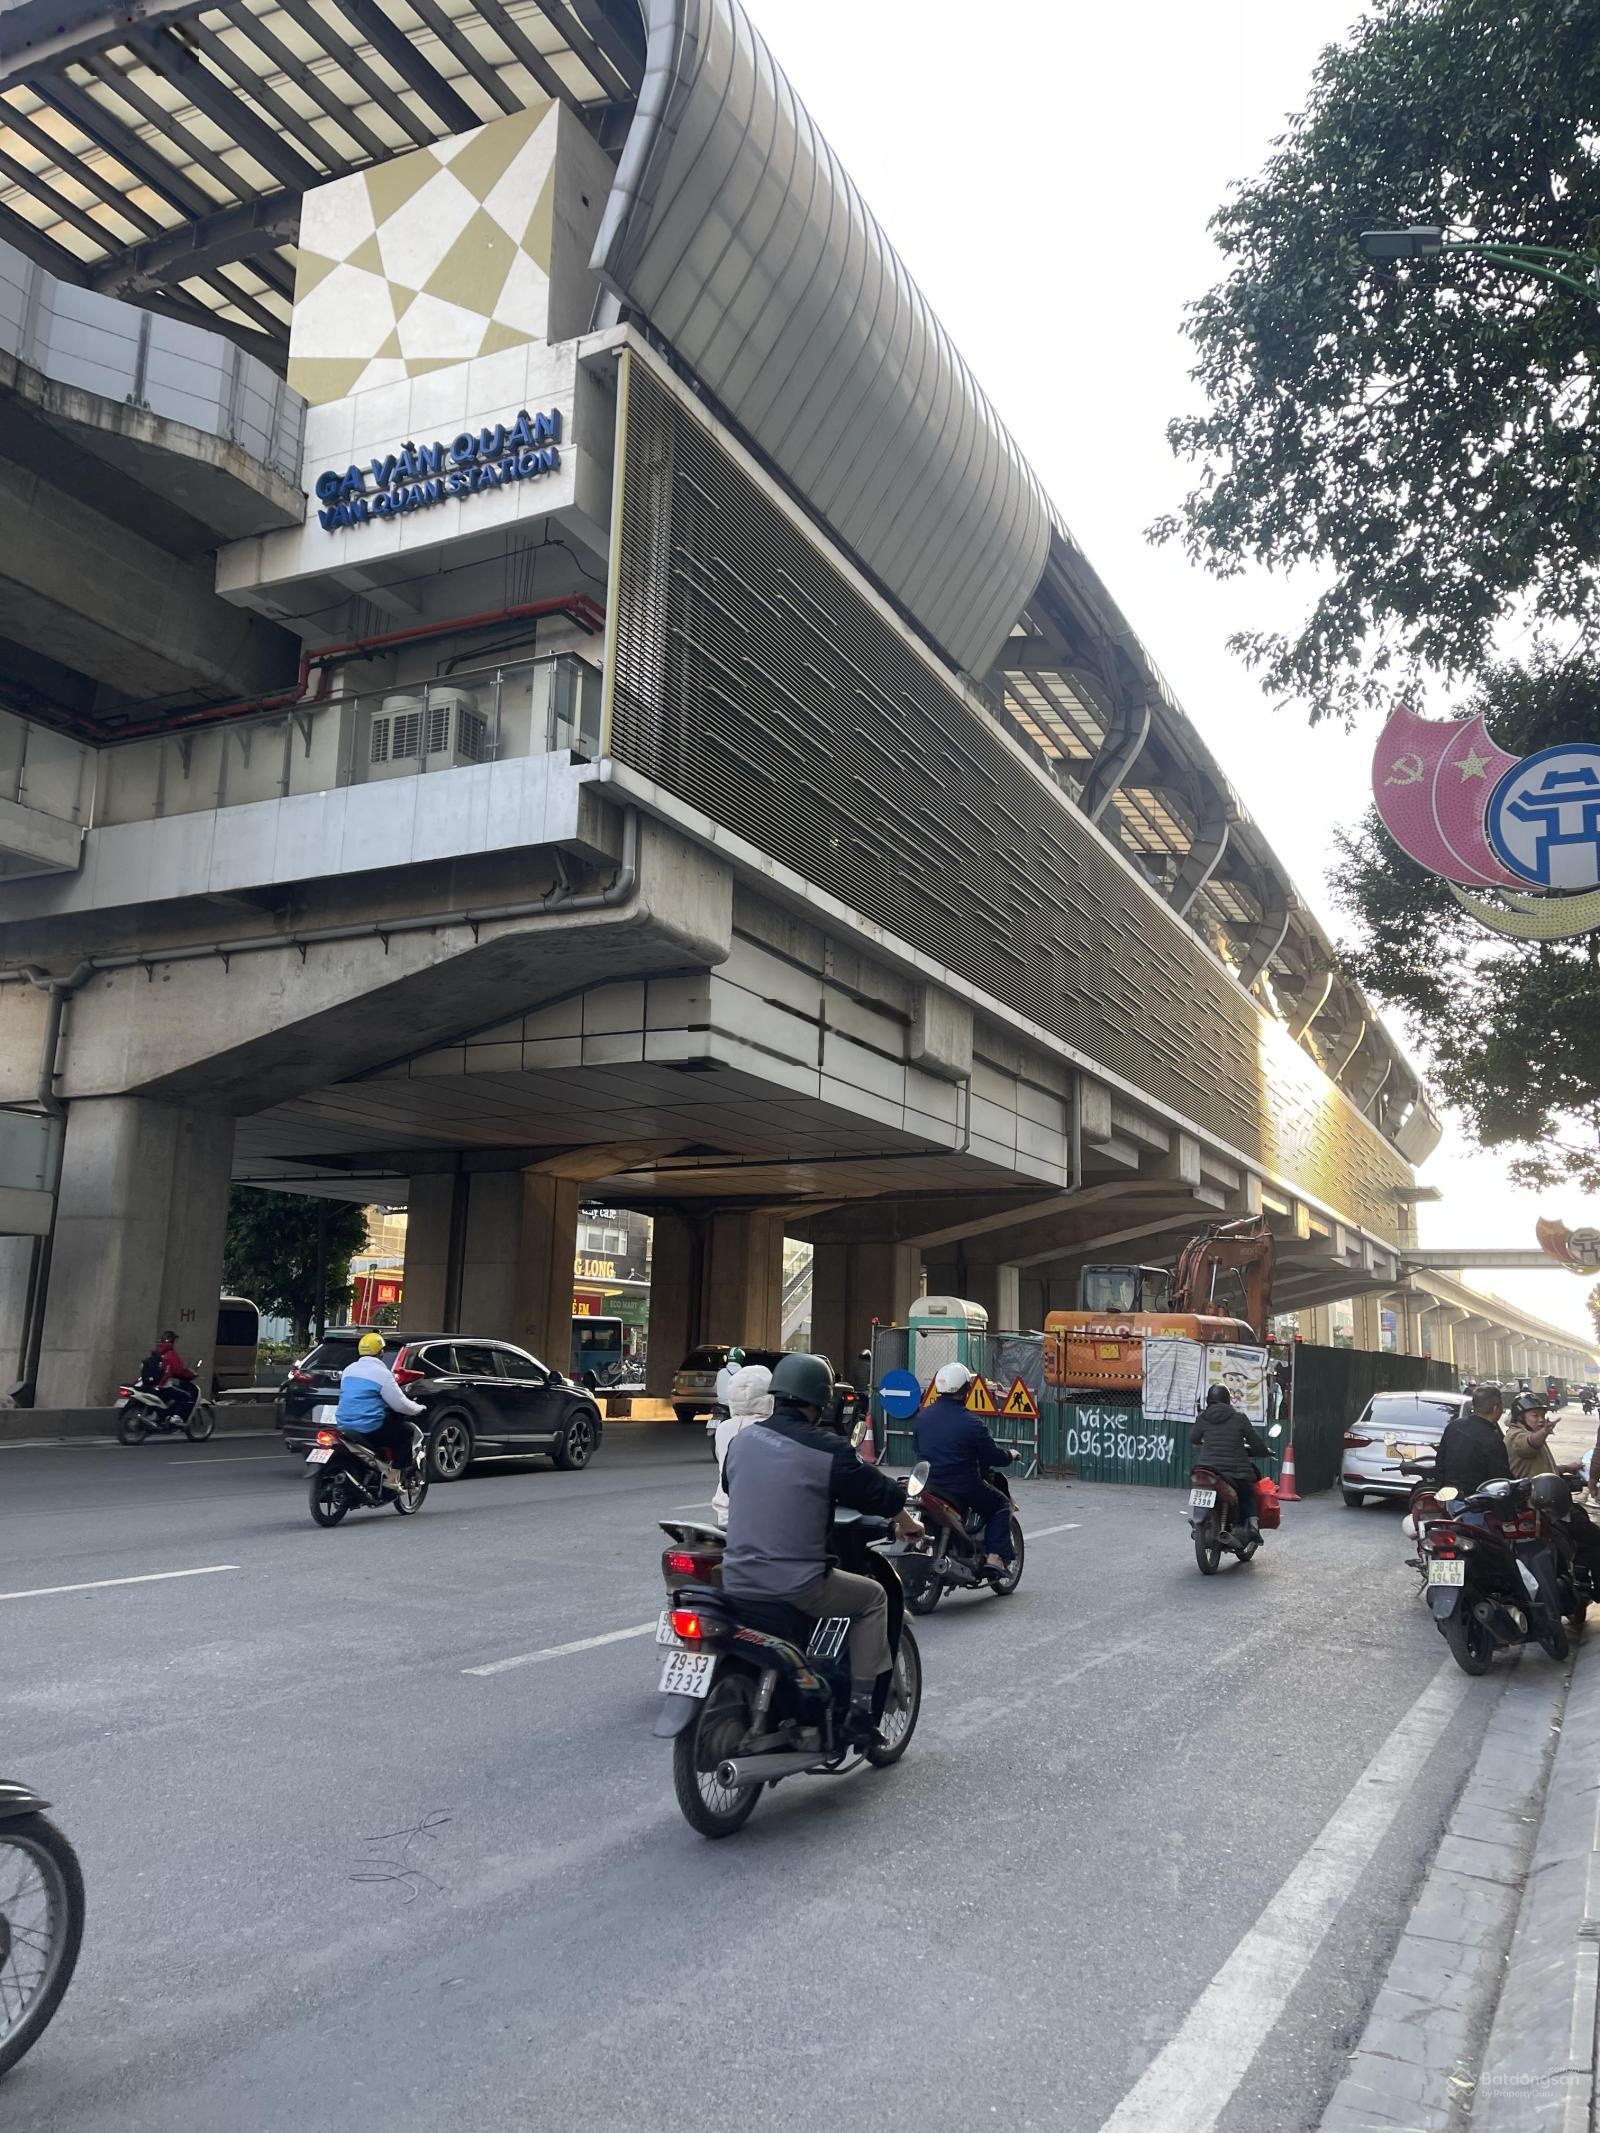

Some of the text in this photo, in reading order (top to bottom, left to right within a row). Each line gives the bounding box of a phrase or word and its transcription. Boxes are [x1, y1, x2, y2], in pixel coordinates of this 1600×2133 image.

[315, 465, 366, 502] GA
[317, 447, 562, 531] VAN QUAN STATION
[584, 1259, 615, 1279] LONG
[180, 1308, 196, 1322] H1
[1103, 1413, 1128, 1430] xe
[670, 1653, 709, 1674] 29-S3
